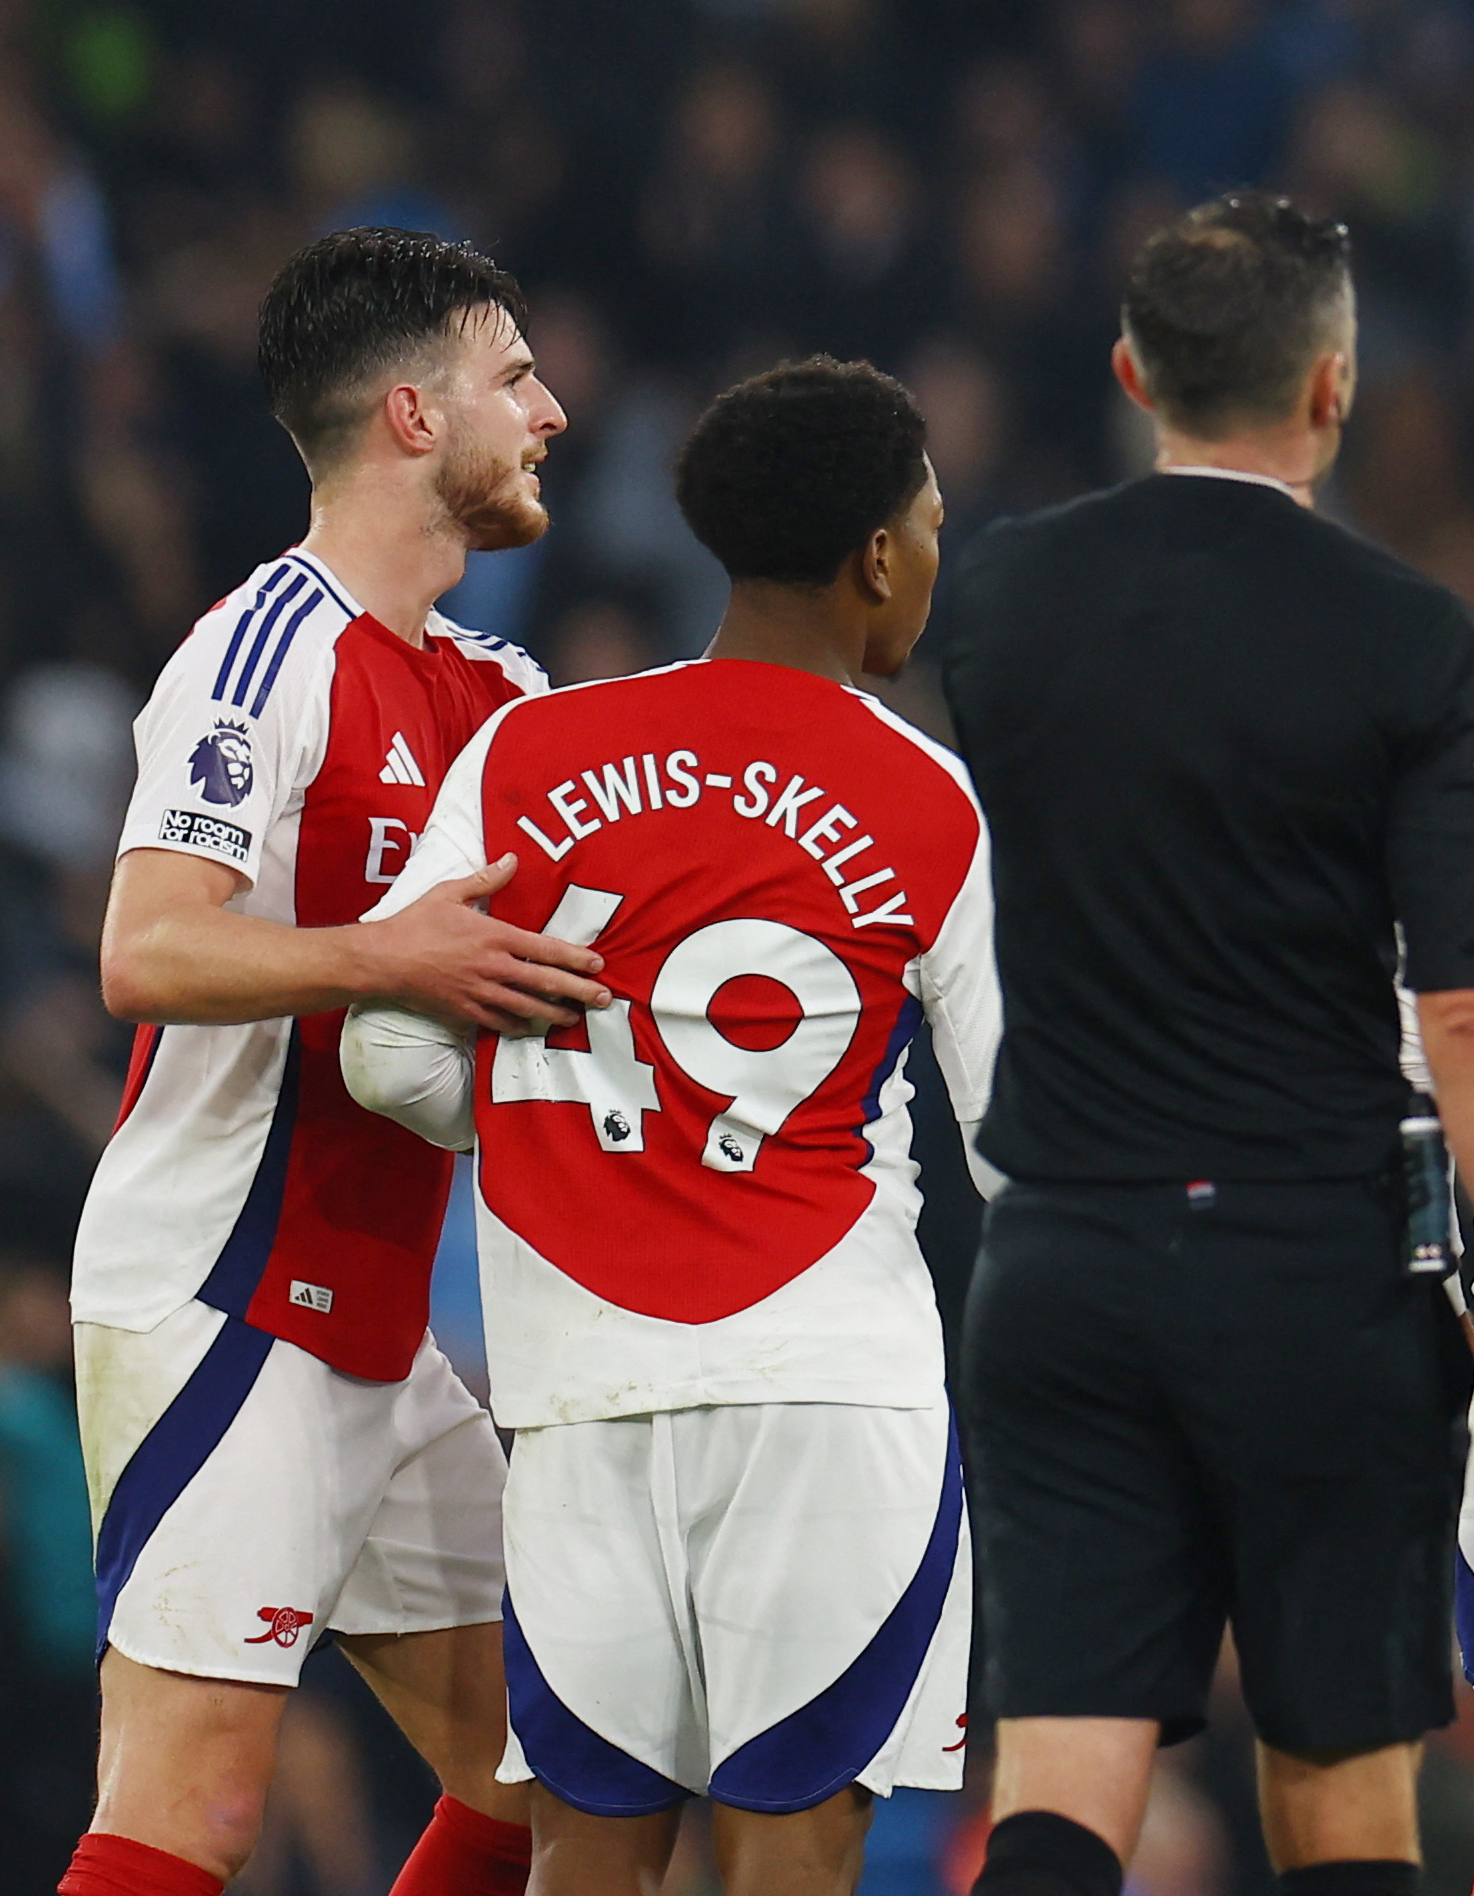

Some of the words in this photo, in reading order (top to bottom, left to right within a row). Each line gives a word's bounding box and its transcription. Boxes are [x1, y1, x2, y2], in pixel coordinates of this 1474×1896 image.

[159, 824, 188, 842] for
[189, 831, 248, 863] racism
[162, 810, 192, 828] No
[193, 817, 244, 845] room
[516, 749, 915, 930] LEWIS-SKELLY
[491, 883, 862, 1173] 49
